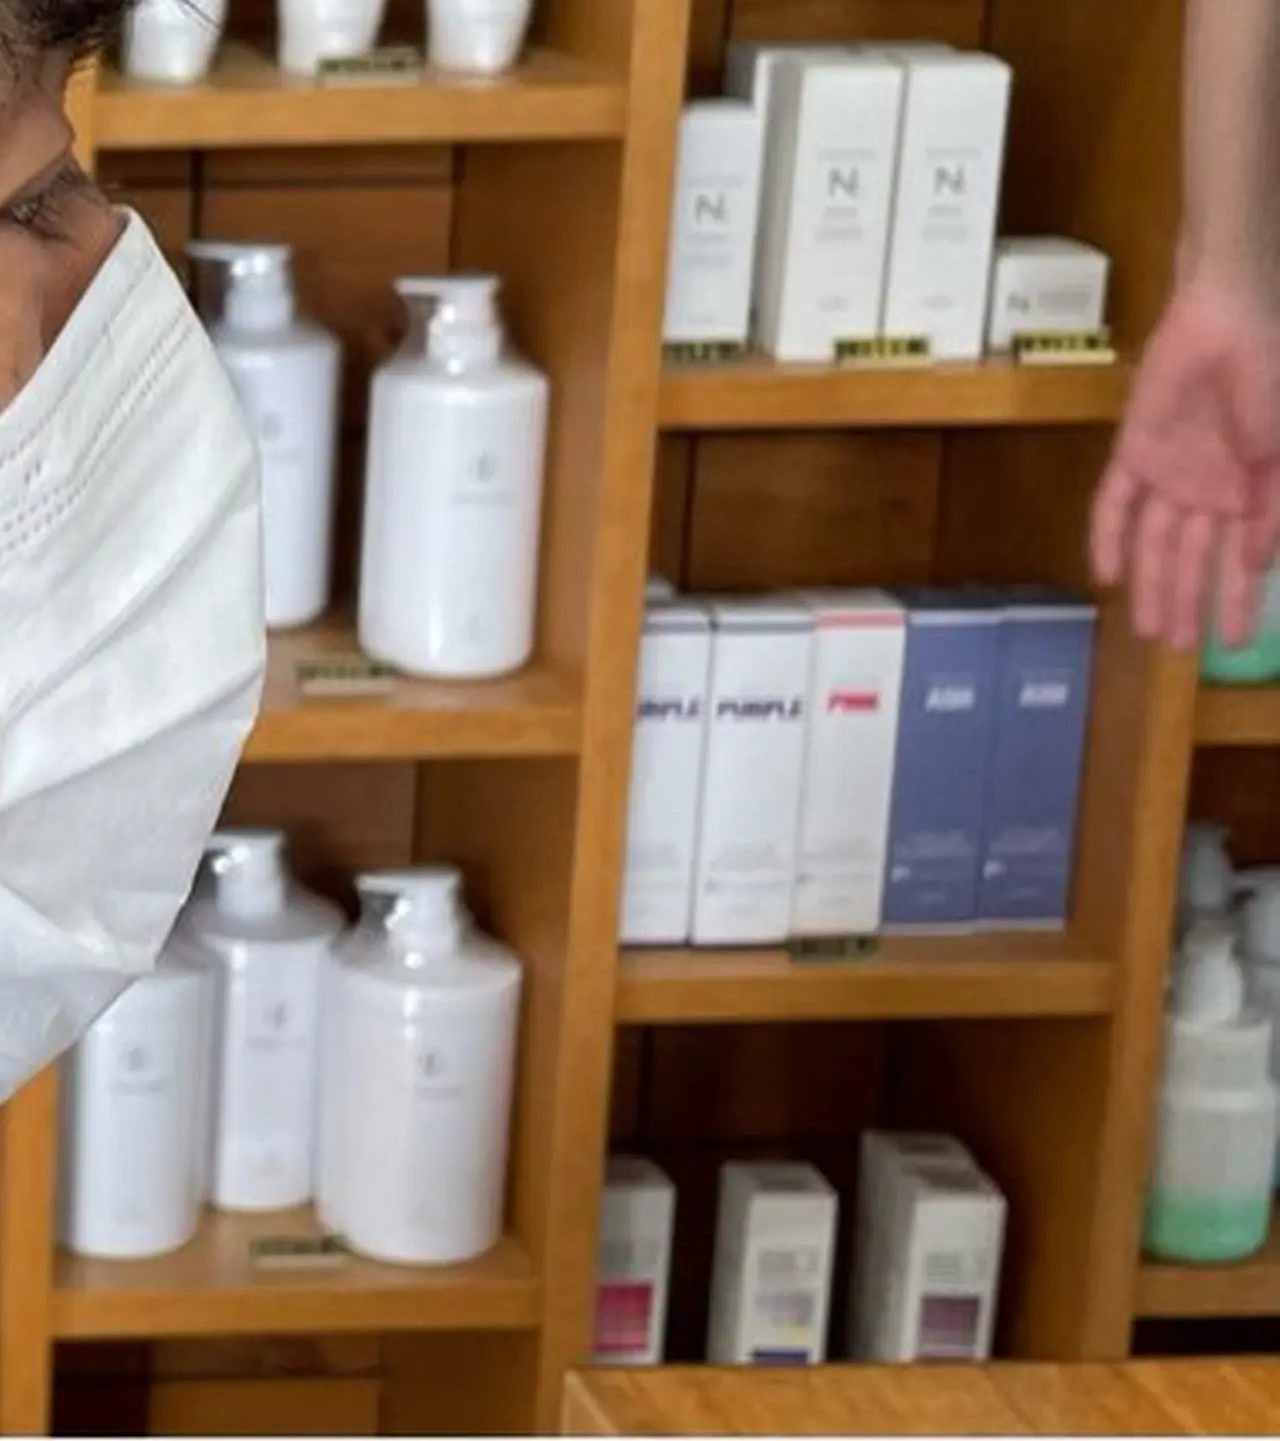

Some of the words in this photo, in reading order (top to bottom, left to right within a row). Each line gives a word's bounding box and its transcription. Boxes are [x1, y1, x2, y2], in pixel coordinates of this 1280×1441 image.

[832, 167, 860, 198] N
[935, 165, 966, 196] N
[695, 193, 725, 225] N
